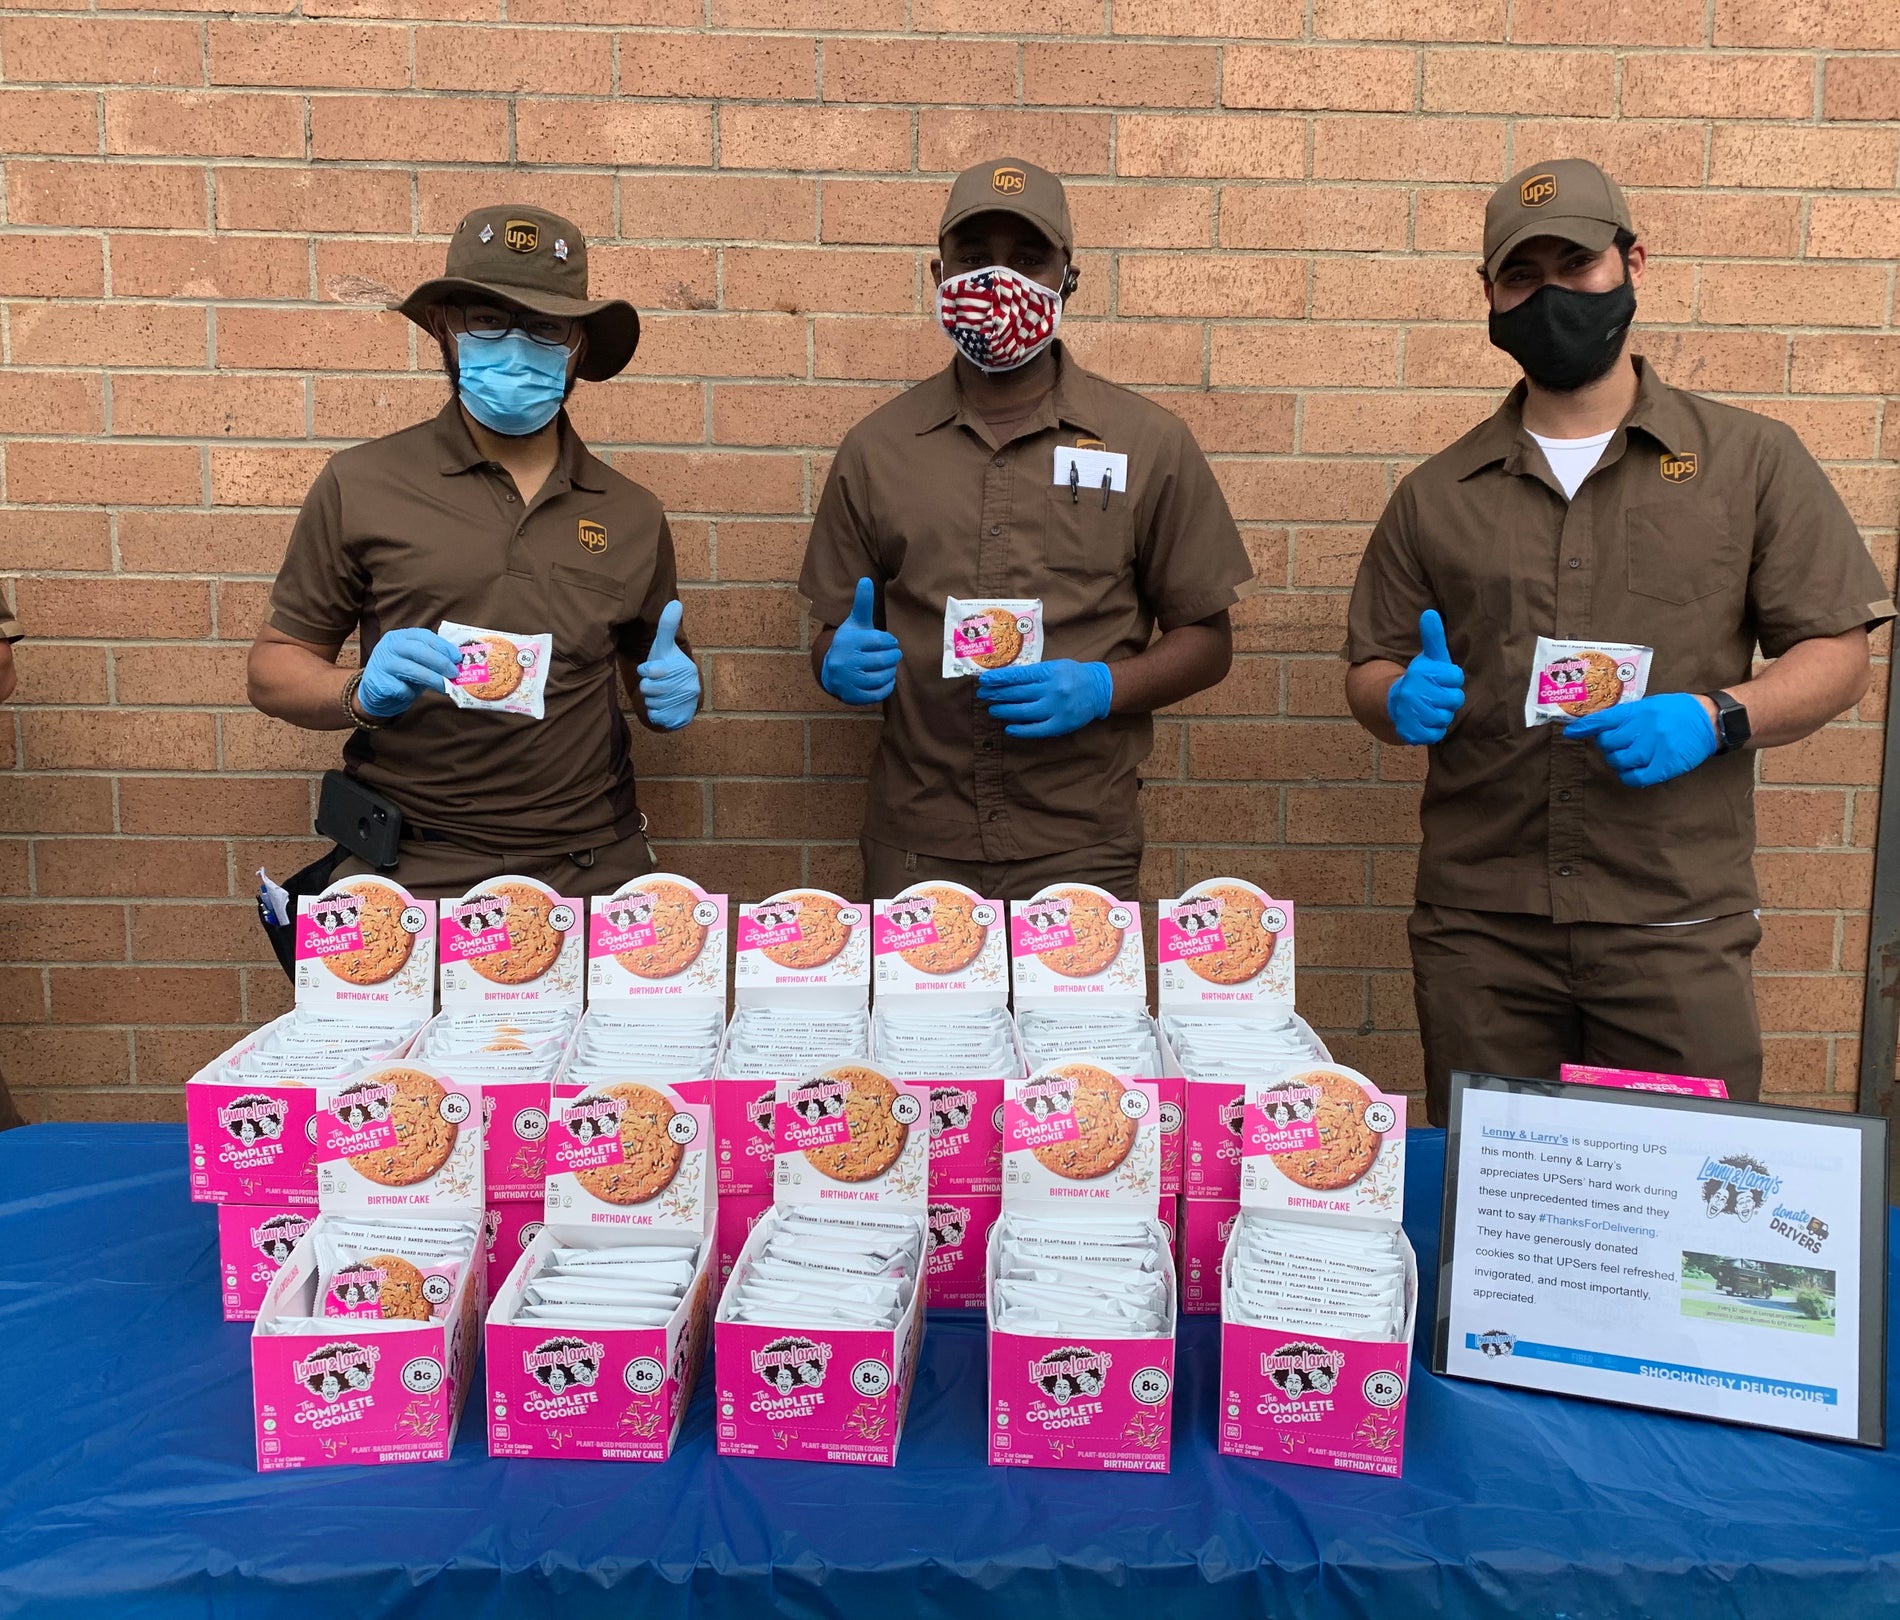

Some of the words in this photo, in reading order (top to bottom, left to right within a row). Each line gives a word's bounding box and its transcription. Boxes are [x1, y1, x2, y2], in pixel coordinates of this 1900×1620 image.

[995, 175, 1023, 191] ups
[1523, 181, 1554, 202] ups
[507, 230, 536, 249] ups
[1663, 460, 1695, 479] ups
[581, 528, 605, 548] ups
[1541, 687, 1583, 697] COMPLETE
[305, 932, 358, 948] COMPLETE
[450, 933, 505, 951] COMPLETE
[1168, 934, 1220, 951] COMPLETE
[665, 986, 682, 994] CAKE
[915, 982, 948, 990] BIRTHDAY
[336, 992, 370, 1000] BIRTHDAY
[448, 1103, 462, 1113] 8G
[899, 1104, 912, 1113] 8G
[1127, 1100, 1141, 1108] 8G
[524, 1119, 538, 1129] 8G
[1372, 1112, 1387, 1122] 8G
[675, 1123, 689, 1133] 8G
[784, 1123, 844, 1141] COMPLETE
[1013, 1119, 1073, 1139] COMPLETE
[327, 1126, 390, 1149] COMPLETE
[797, 1134, 834, 1147] COOKIE
[1026, 1131, 1064, 1145] COOKIE
[1252, 1128, 1314, 1144] COMPLETE
[1482, 1126, 1515, 1140] Lenny
[1519, 1130, 1527, 1139] &
[1531, 1131, 1568, 1144] Larry's
[1572, 1136, 1580, 1145] is
[1584, 1138, 1638, 1153] supporting
[1642, 1144, 1667, 1154] UPS
[341, 1140, 380, 1155] COOKIE
[555, 1142, 618, 1162] COMPLETE
[1265, 1140, 1304, 1151] COOKIE
[219, 1144, 283, 1163] COMPLETE
[1481, 1146, 1499, 1156] this
[1502, 1150, 1536, 1160] month.
[1541, 1153, 1572, 1166] Lenny
[1576, 1157, 1583, 1165] &
[1587, 1158, 1621, 1171] Larry's
[234, 1156, 274, 1169] COOKIE
[569, 1155, 607, 1168] COOKIE
[1480, 1167, 1539, 1181] appreciates
[1543, 1173, 1585, 1186] UPSers'
[1589, 1178, 1612, 1189] hard
[1615, 1182, 1641, 1193] work
[1644, 1186, 1678, 1199] during
[368, 1196, 408, 1204] BIRTHDAY
[410, 1195, 430, 1203] CAKE
[494, 1191, 529, 1199] BIRTHDAY
[820, 1190, 857, 1200] BIRTHDAY
[860, 1192, 879, 1201] CAKE
[1050, 1188, 1089, 1197] BIRTHDAY
[1090, 1189, 1110, 1198] CAKE
[1288, 1197, 1328, 1208] BIRTHDAY
[1330, 1202, 1350, 1211] CAKE
[1479, 1186, 1507, 1197] these
[1511, 1191, 1588, 1207] unprecedented
[1591, 1200, 1619, 1211] times
[1623, 1205, 1643, 1214] and
[1647, 1206, 1669, 1218] they
[592, 1214, 630, 1223] BIRTHDAY
[632, 1216, 652, 1225] CAKE
[1772, 1203, 1810, 1223] donate
[1478, 1207, 1502, 1218] want
[1505, 1209, 1515, 1218] to
[1519, 1212, 1536, 1223] say
[1539, 1213, 1658, 1238] #ThanksForDelivering.
[1477, 1226, 1501, 1239] They
[1506, 1230, 1530, 1241] have
[1534, 1233, 1591, 1250] generously
[1595, 1242, 1638, 1255] donated
[1769, 1217, 1822, 1254] DRIVERS
[1475, 1248, 1514, 1259] cookies
[1518, 1253, 1530, 1261] so
[1533, 1254, 1553, 1265] that
[1557, 1256, 1597, 1271] UPSers
[1600, 1262, 1620, 1273] feel
[1623, 1266, 1677, 1282] refreshed,
[1474, 1267, 1534, 1284] invigorated,
[1538, 1276, 1557, 1286] and
[1560, 1280, 1587, 1290] most
[1590, 1282, 1650, 1300] importantly,
[1473, 1288, 1536, 1304] appreciated.
[414, 1371, 431, 1381] 8G
[636, 1371, 653, 1381] 8G
[862, 1372, 879, 1383] 8G
[1142, 1380, 1159, 1391] 8G
[1374, 1383, 1392, 1394] 8G
[1640, 1365, 1736, 1390] SHOCKINGLY
[1741, 1381, 1824, 1403] DELICIOUS
[523, 1392, 598, 1412] COMPLETE
[750, 1393, 825, 1412] COMPLETE
[1257, 1401, 1334, 1415] COMPLETE
[294, 1396, 375, 1424] COMPLETE
[540, 1406, 587, 1420] COOKIE
[766, 1407, 813, 1421] COOKIE
[1026, 1402, 1103, 1422] COMPLETE
[312, 1411, 362, 1430] COOKIE
[1043, 1417, 1090, 1430] COOKIE
[1273, 1413, 1322, 1424] COOKIE
[380, 1452, 420, 1462] BIRTHDAY
[423, 1450, 444, 1459] CAKE
[602, 1450, 641, 1458] BIRTHDAY
[827, 1451, 866, 1461] BIRTHDAY
[868, 1454, 888, 1463] CAKE
[1308, 1447, 1347, 1458] PLANT-BASED
[1348, 1452, 1372, 1461] PROTEIN
[1373, 1455, 1397, 1464] COOKIES
[1104, 1460, 1143, 1469] BIRTHDAY
[1145, 1462, 1165, 1470] CAKE
[1334, 1459, 1375, 1471] BIRTHDAY
[1377, 1464, 1397, 1474] CAKE
